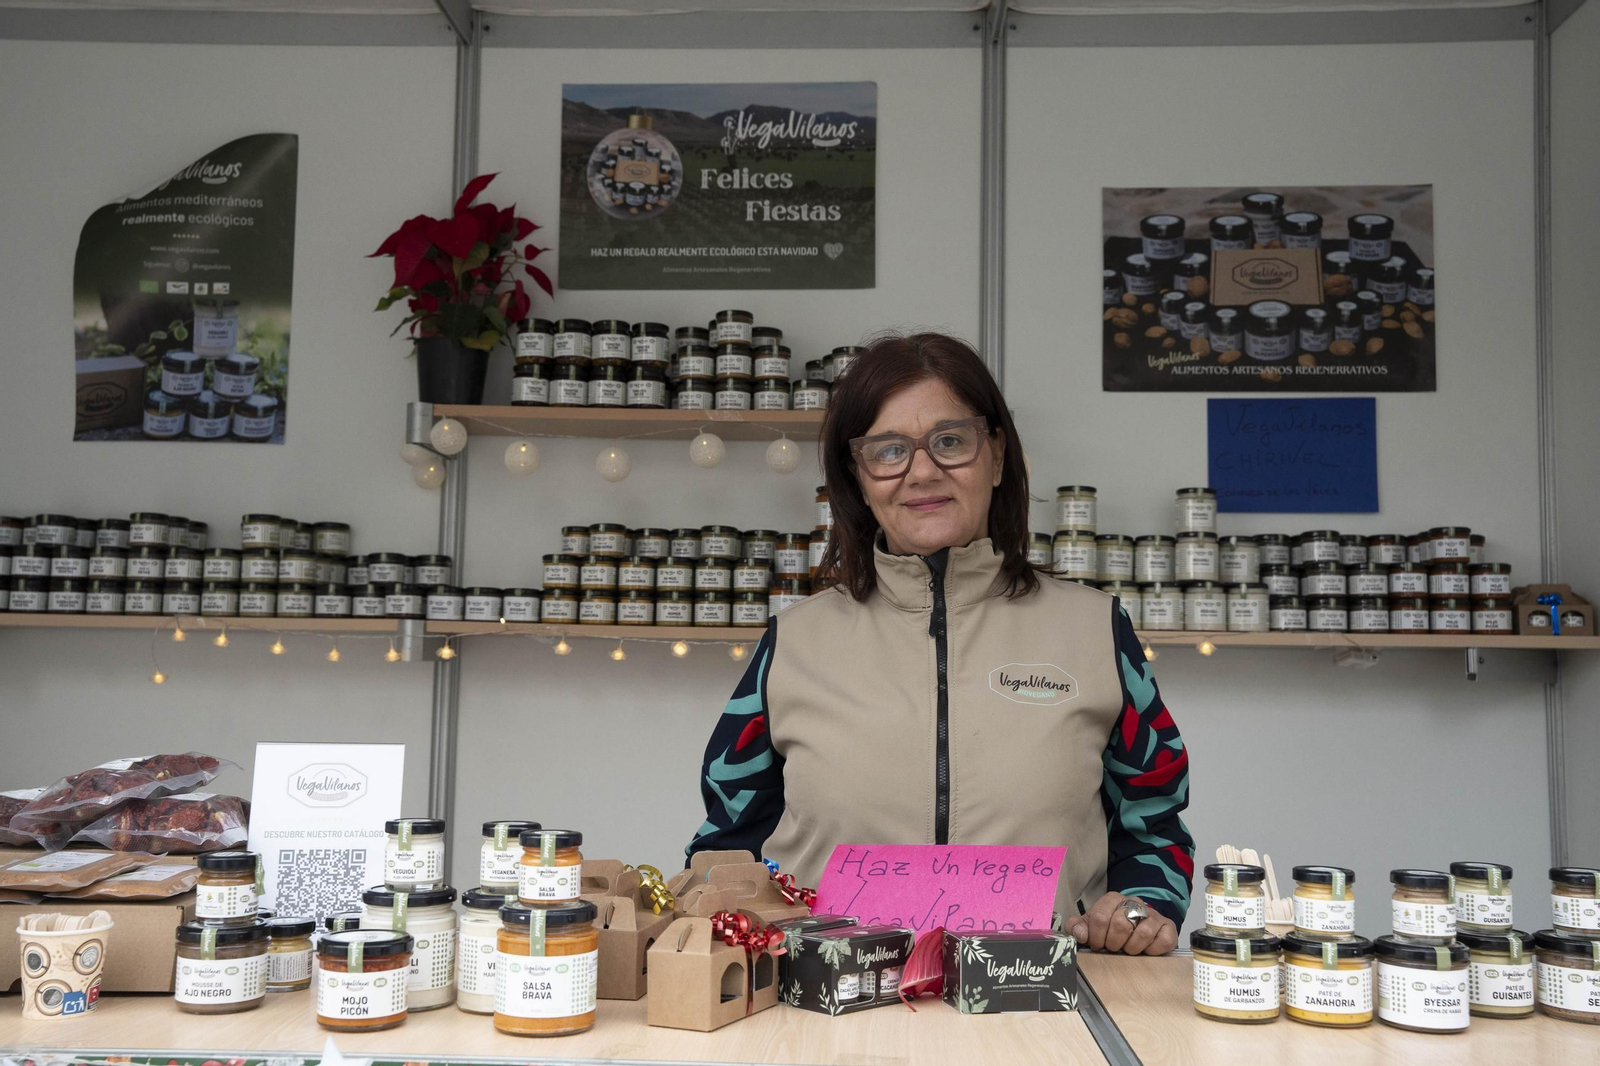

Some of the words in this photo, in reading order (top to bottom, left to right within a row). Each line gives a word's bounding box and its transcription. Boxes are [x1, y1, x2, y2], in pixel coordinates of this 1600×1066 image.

[736, 110, 858, 148] VegaVilanos
[700, 168, 793, 189] Felices
[115, 196, 171, 213] Alimentos
[174, 194, 264, 208] mediterráneos
[746, 200, 841, 221] Fiestas
[122, 213, 185, 226] realmente
[188, 213, 254, 228] ecológicos
[591, 248, 607, 256] HAZ
[609, 248, 622, 256] UN
[623, 248, 656, 256] REGALO
[658, 248, 708, 256] REALMENTE
[709, 245, 756, 256] ECOLÓGICO
[757, 248, 779, 256] ESTA
[780, 248, 818, 256] NAVIDAD
[1239, 267, 1293, 282] VegaVilanos
[1148, 352, 1200, 370] VegaVilanos
[1171, 365, 1230, 375] ALIMENTOS
[1231, 365, 1293, 375] ARTESANOS
[1295, 365, 1388, 375] REGENERRATIVOS
[1000, 672, 1071, 693] VegaVilanos
[296, 776, 362, 796] VegaVilanos
[264, 831, 305, 839] DESCUBRE
[344, 828, 384, 838] CATÁLOGO
[838, 848, 910, 878] Haz
[932, 852, 960, 876] Un
[973, 858, 1054, 894] regalo
[856, 946, 899, 969] VegaVilanos
[987, 958, 1054, 983] VegaVilanos
[185, 988, 199, 997] AJO
[201, 988, 232, 997] NEGRO
[523, 982, 552, 990] SALSA
[1229, 988, 1261, 997] HUMUS
[342, 996, 368, 1005] MOJO
[522, 991, 552, 1000] BRAVA
[1306, 996, 1356, 1007] ZANAHORIA
[1492, 990, 1532, 1000] GUISANTES
[1424, 998, 1461, 1007] BYESSAR
[341, 1005, 369, 1015] PICÓN
